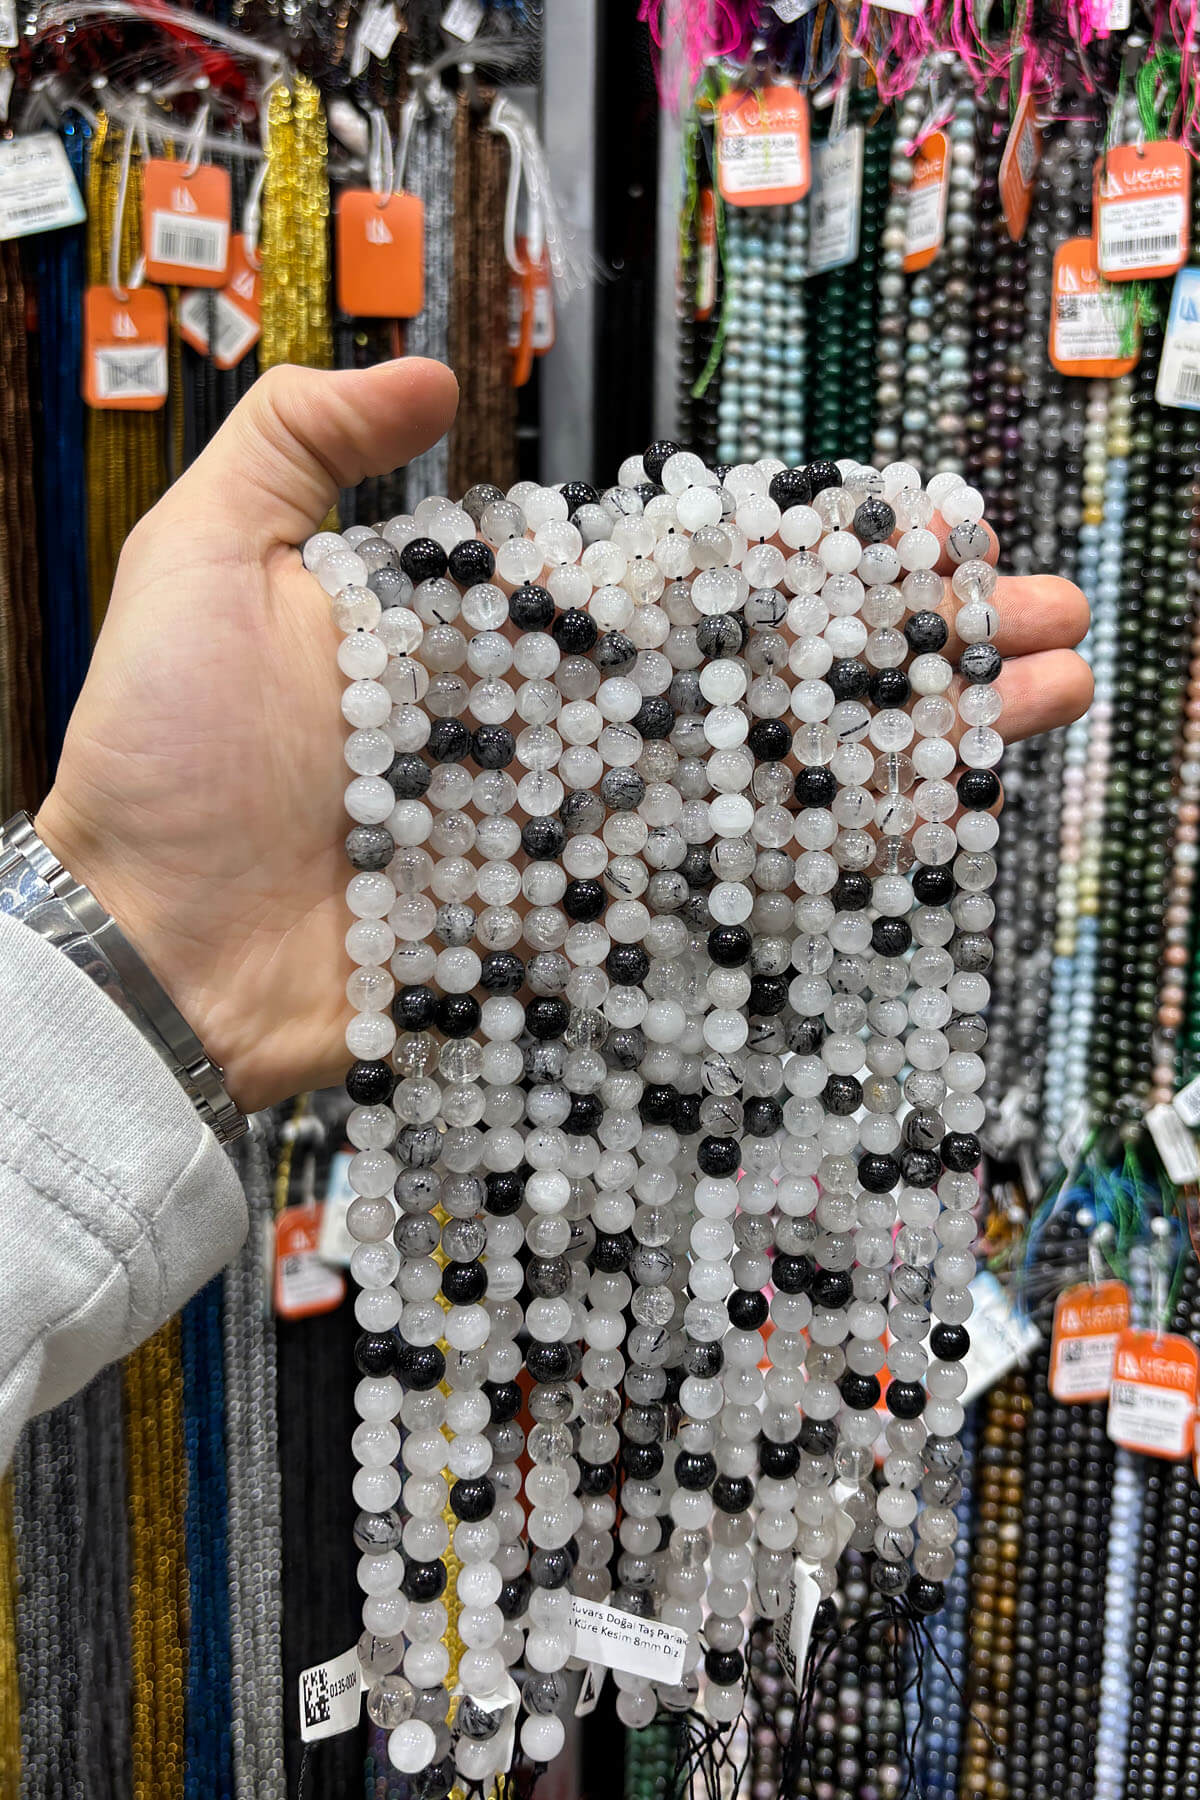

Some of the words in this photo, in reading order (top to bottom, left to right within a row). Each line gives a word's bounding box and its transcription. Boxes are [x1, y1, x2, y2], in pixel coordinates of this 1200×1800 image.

[574, 1618, 598, 1634] Küre
[600, 1626, 632, 1644] Kesim
[633, 1636, 661, 1652] 8mm
[638, 1623, 655, 1638] Taş
